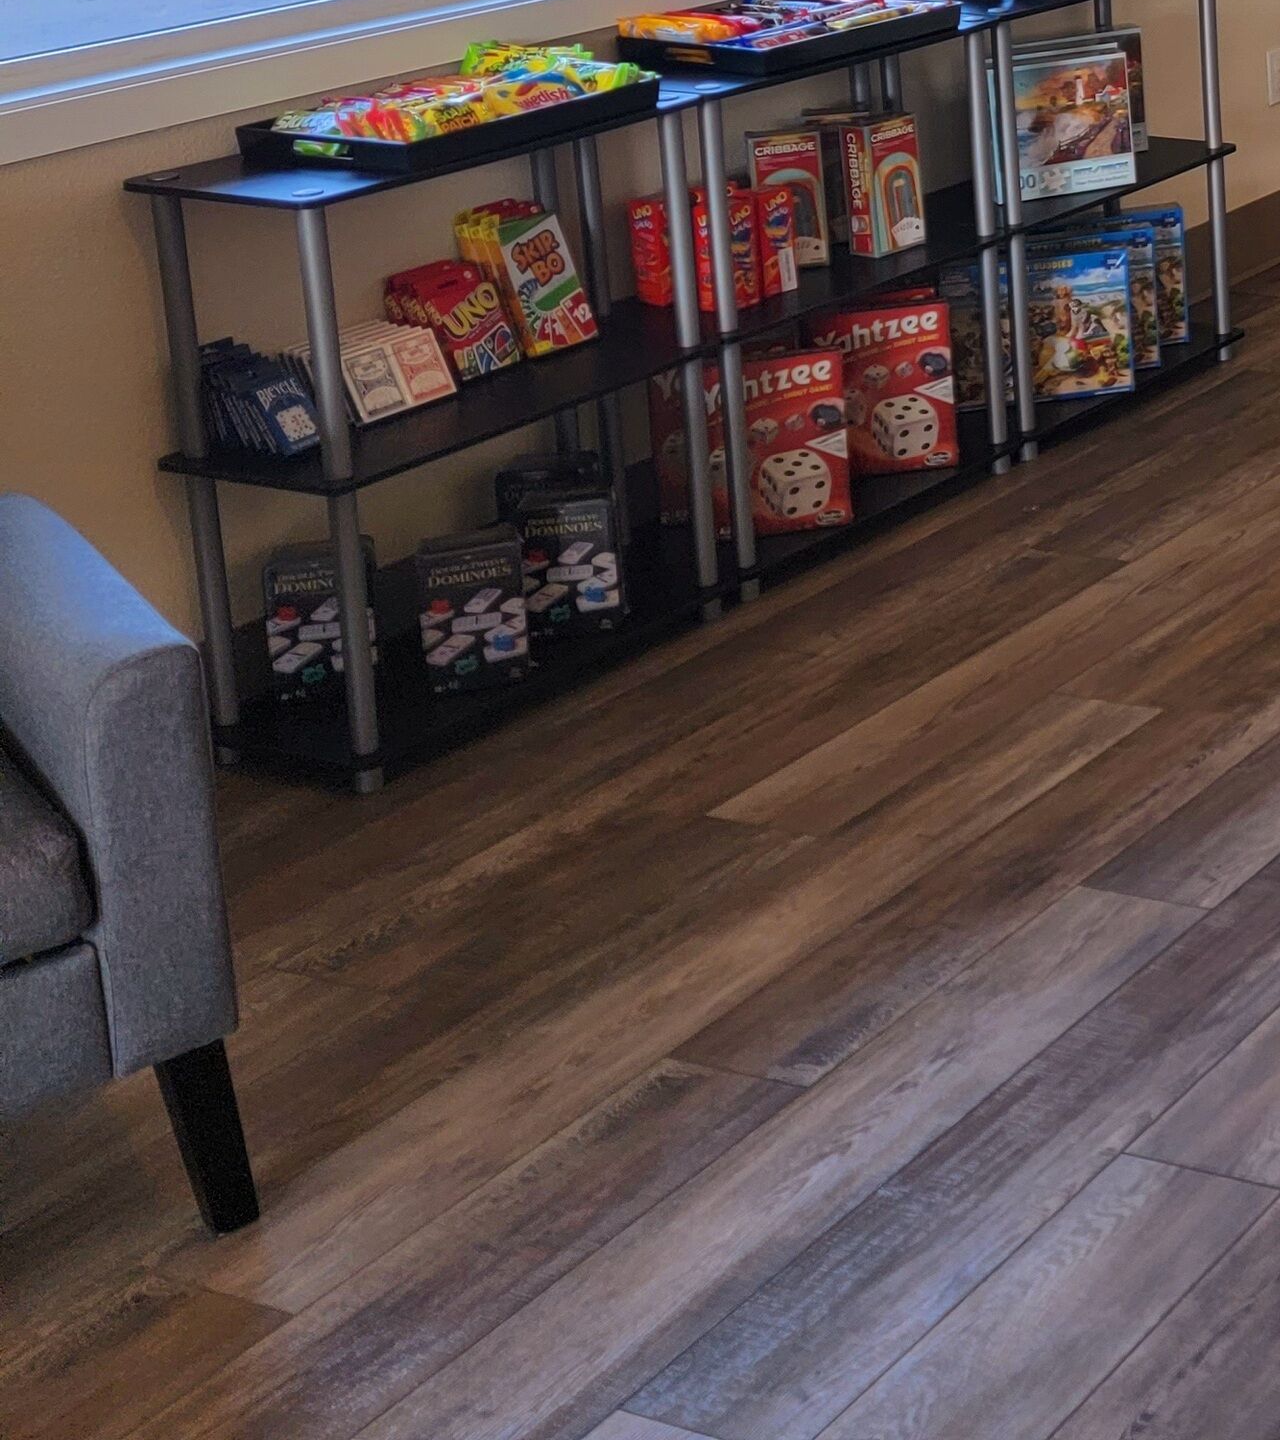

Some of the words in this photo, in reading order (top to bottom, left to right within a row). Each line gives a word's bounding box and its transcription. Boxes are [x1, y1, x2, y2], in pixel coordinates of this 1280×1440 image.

[754, 30, 808, 49] CRUNCH
[435, 103, 474, 123] SOUR
[439, 114, 478, 132] PATCH
[871, 124, 915, 144] CRIBBAGE
[754, 141, 815, 157] CRIBBAGE
[845, 132, 864, 211] CRIBBAGE
[764, 191, 788, 211] UNO
[633, 205, 652, 220] UNO
[730, 205, 751, 225] UNO
[531, 252, 565, 287] BO
[442, 282, 499, 338] UNO
[573, 303, 593, 323] 12
[256, 376, 303, 408] BICYCLE
[704, 359, 833, 415] Yhtzee
[524, 520, 602, 538] DOMINOES
[427, 564, 512, 589] DOMINOES
